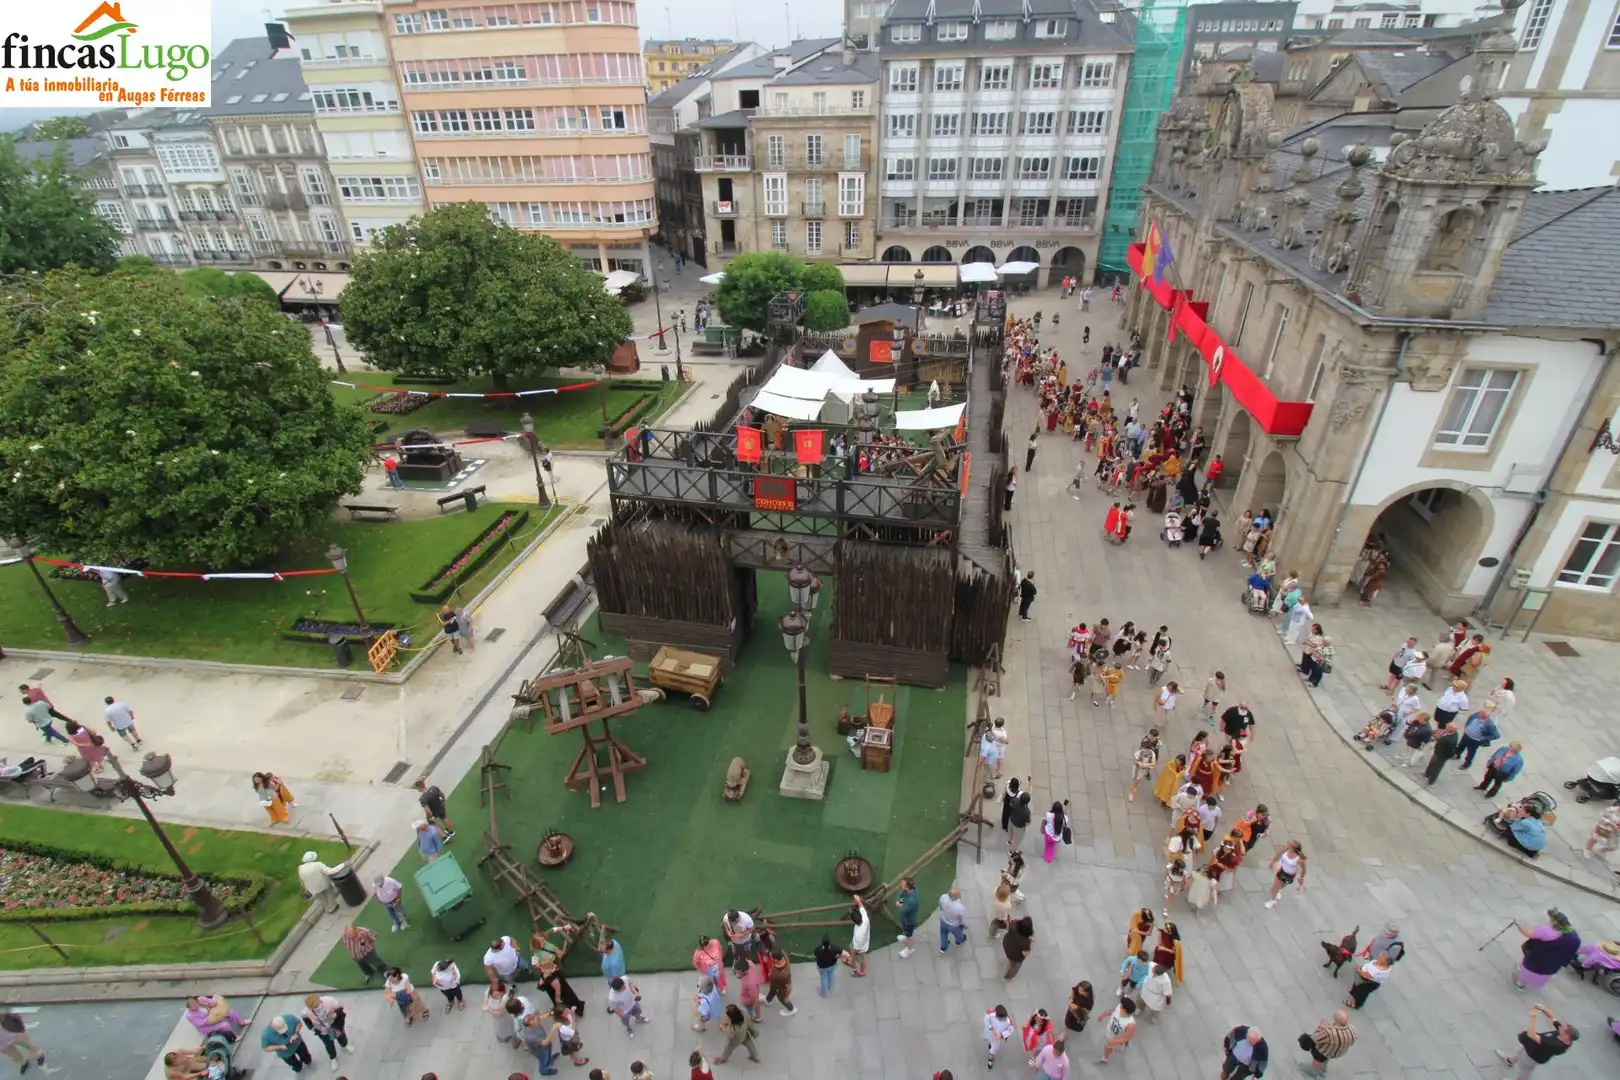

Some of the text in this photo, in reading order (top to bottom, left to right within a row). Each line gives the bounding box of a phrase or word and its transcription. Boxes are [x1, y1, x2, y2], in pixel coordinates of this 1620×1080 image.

[946, 240, 969, 248] BBVA
[990, 240, 1015, 248] BBVA
[1036, 240, 1060, 248] BBVA
